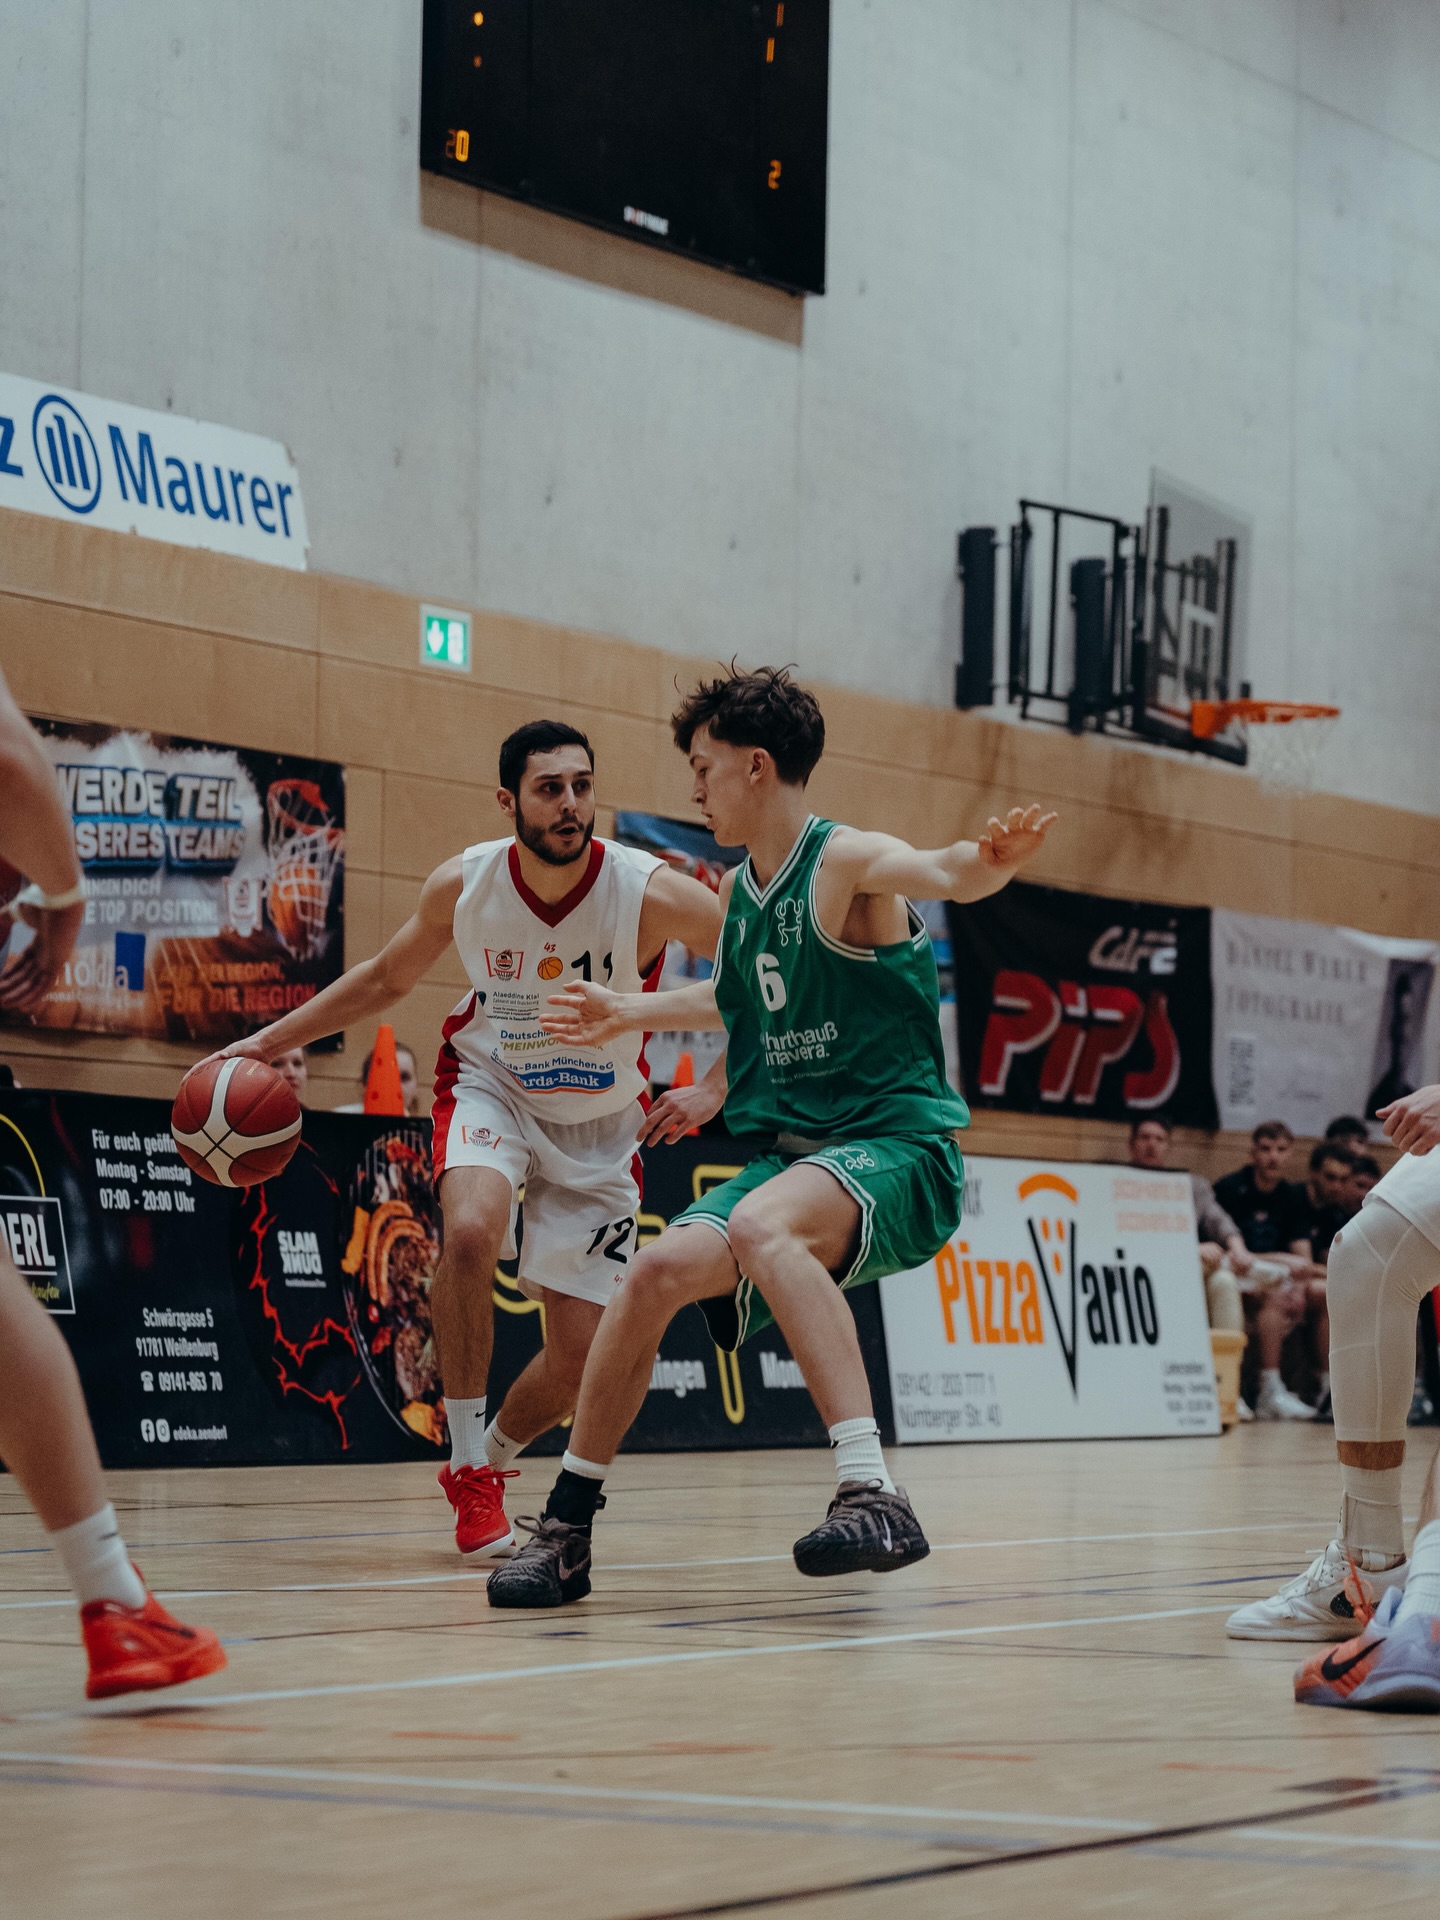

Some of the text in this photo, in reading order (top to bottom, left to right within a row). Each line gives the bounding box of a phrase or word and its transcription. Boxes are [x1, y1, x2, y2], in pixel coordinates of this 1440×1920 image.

[108, 422, 293, 538] Maurer
[174, 774, 243, 822] TEIL
[75, 821, 165, 860] SERES
[755, 952, 787, 1012] 6
[552, 1056, 597, 1070] München
[599, 1061, 614, 1071] eG
[91, 1128, 110, 1150] Für
[113, 1131, 141, 1152] euch
[95, 1158, 138, 1184] Montag
[146, 1160, 192, 1187] Samstag
[99, 1188, 131, 1211] 07:00
[141, 1189, 173, 1212] 20:00
[173, 1190, 195, 1213] Uhr
[277, 1229, 320, 1254] SLAM
[933, 1240, 1045, 1345] Pizza
[142, 1307, 214, 1332] Schwärzgasse 5
[135, 1337, 219, 1362] 91781 Weißenburg
[209, 1371, 223, 1392] 70
